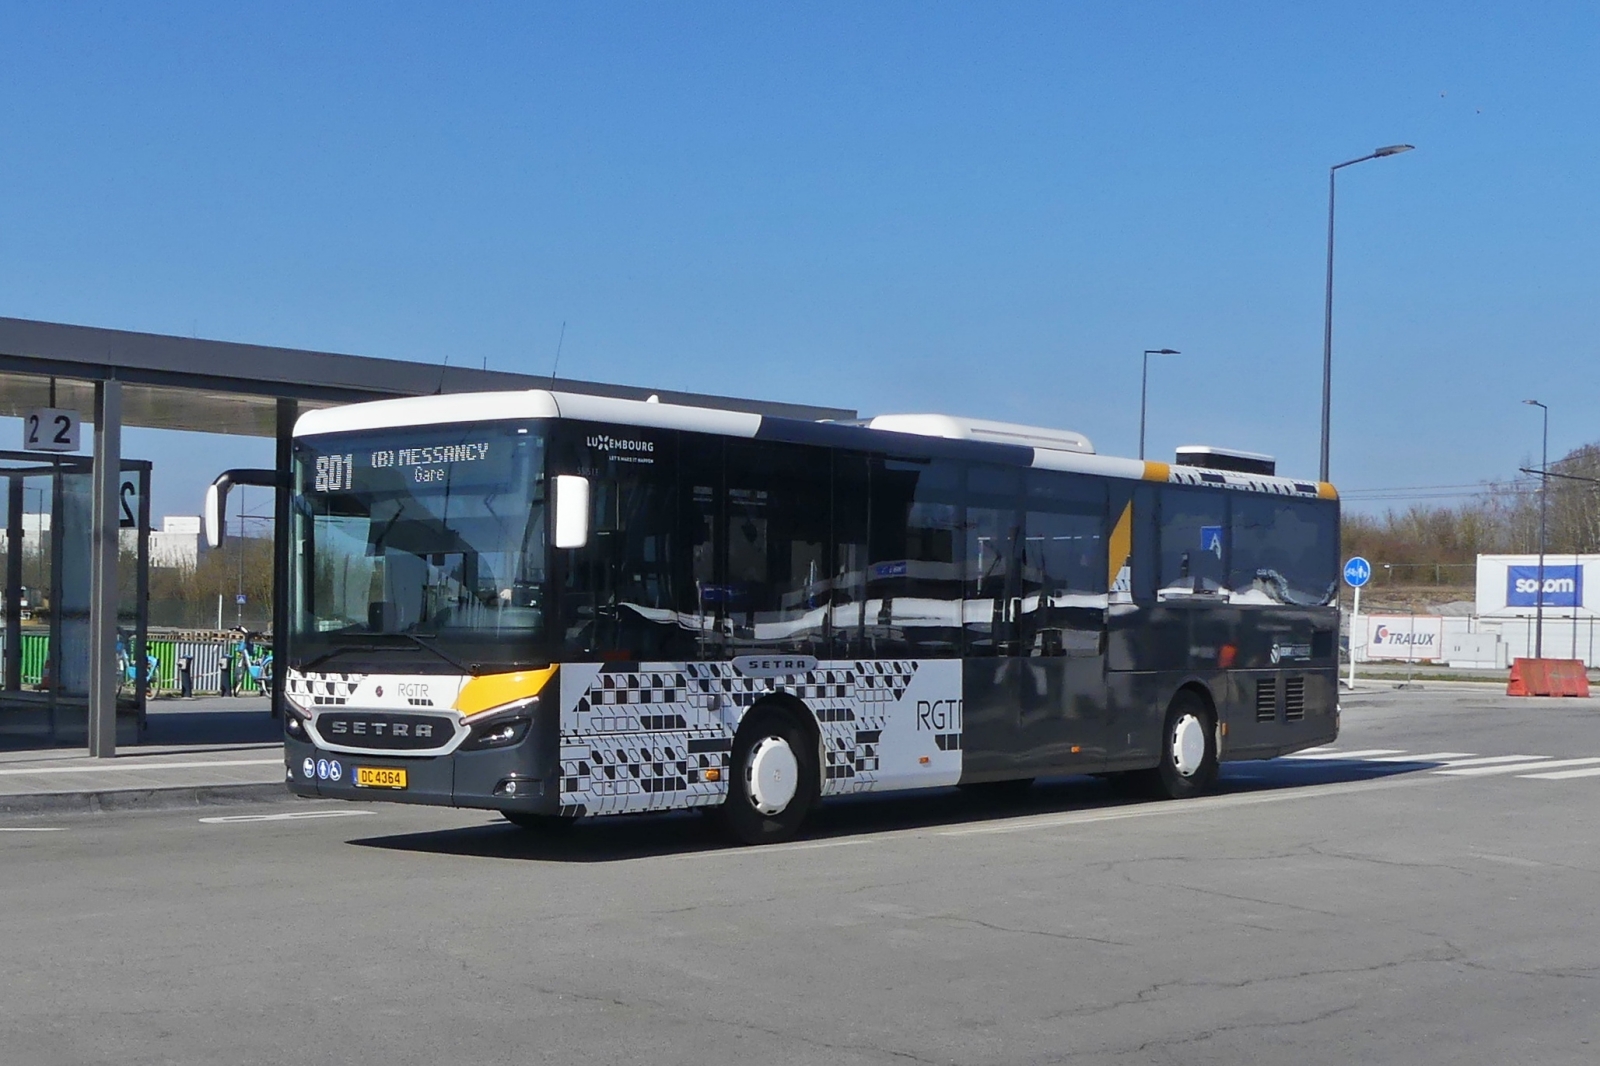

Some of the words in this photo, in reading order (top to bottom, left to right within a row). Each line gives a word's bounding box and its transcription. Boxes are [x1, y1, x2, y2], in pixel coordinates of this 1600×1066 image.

[29, 414, 39, 443] 2
[53, 415, 71, 444] 2
[586, 434, 654, 452] LUXEMBOURG
[371, 450, 394, 468] (B)
[398, 442, 489, 467] MESSANCY
[315, 453, 353, 494] 801
[414, 466, 445, 483] Gare
[1388, 632, 1435, 645] TRALUX
[749, 660, 806, 669] SETRA
[397, 683, 429, 698] RGTR
[332, 721, 433, 737] SETRA
